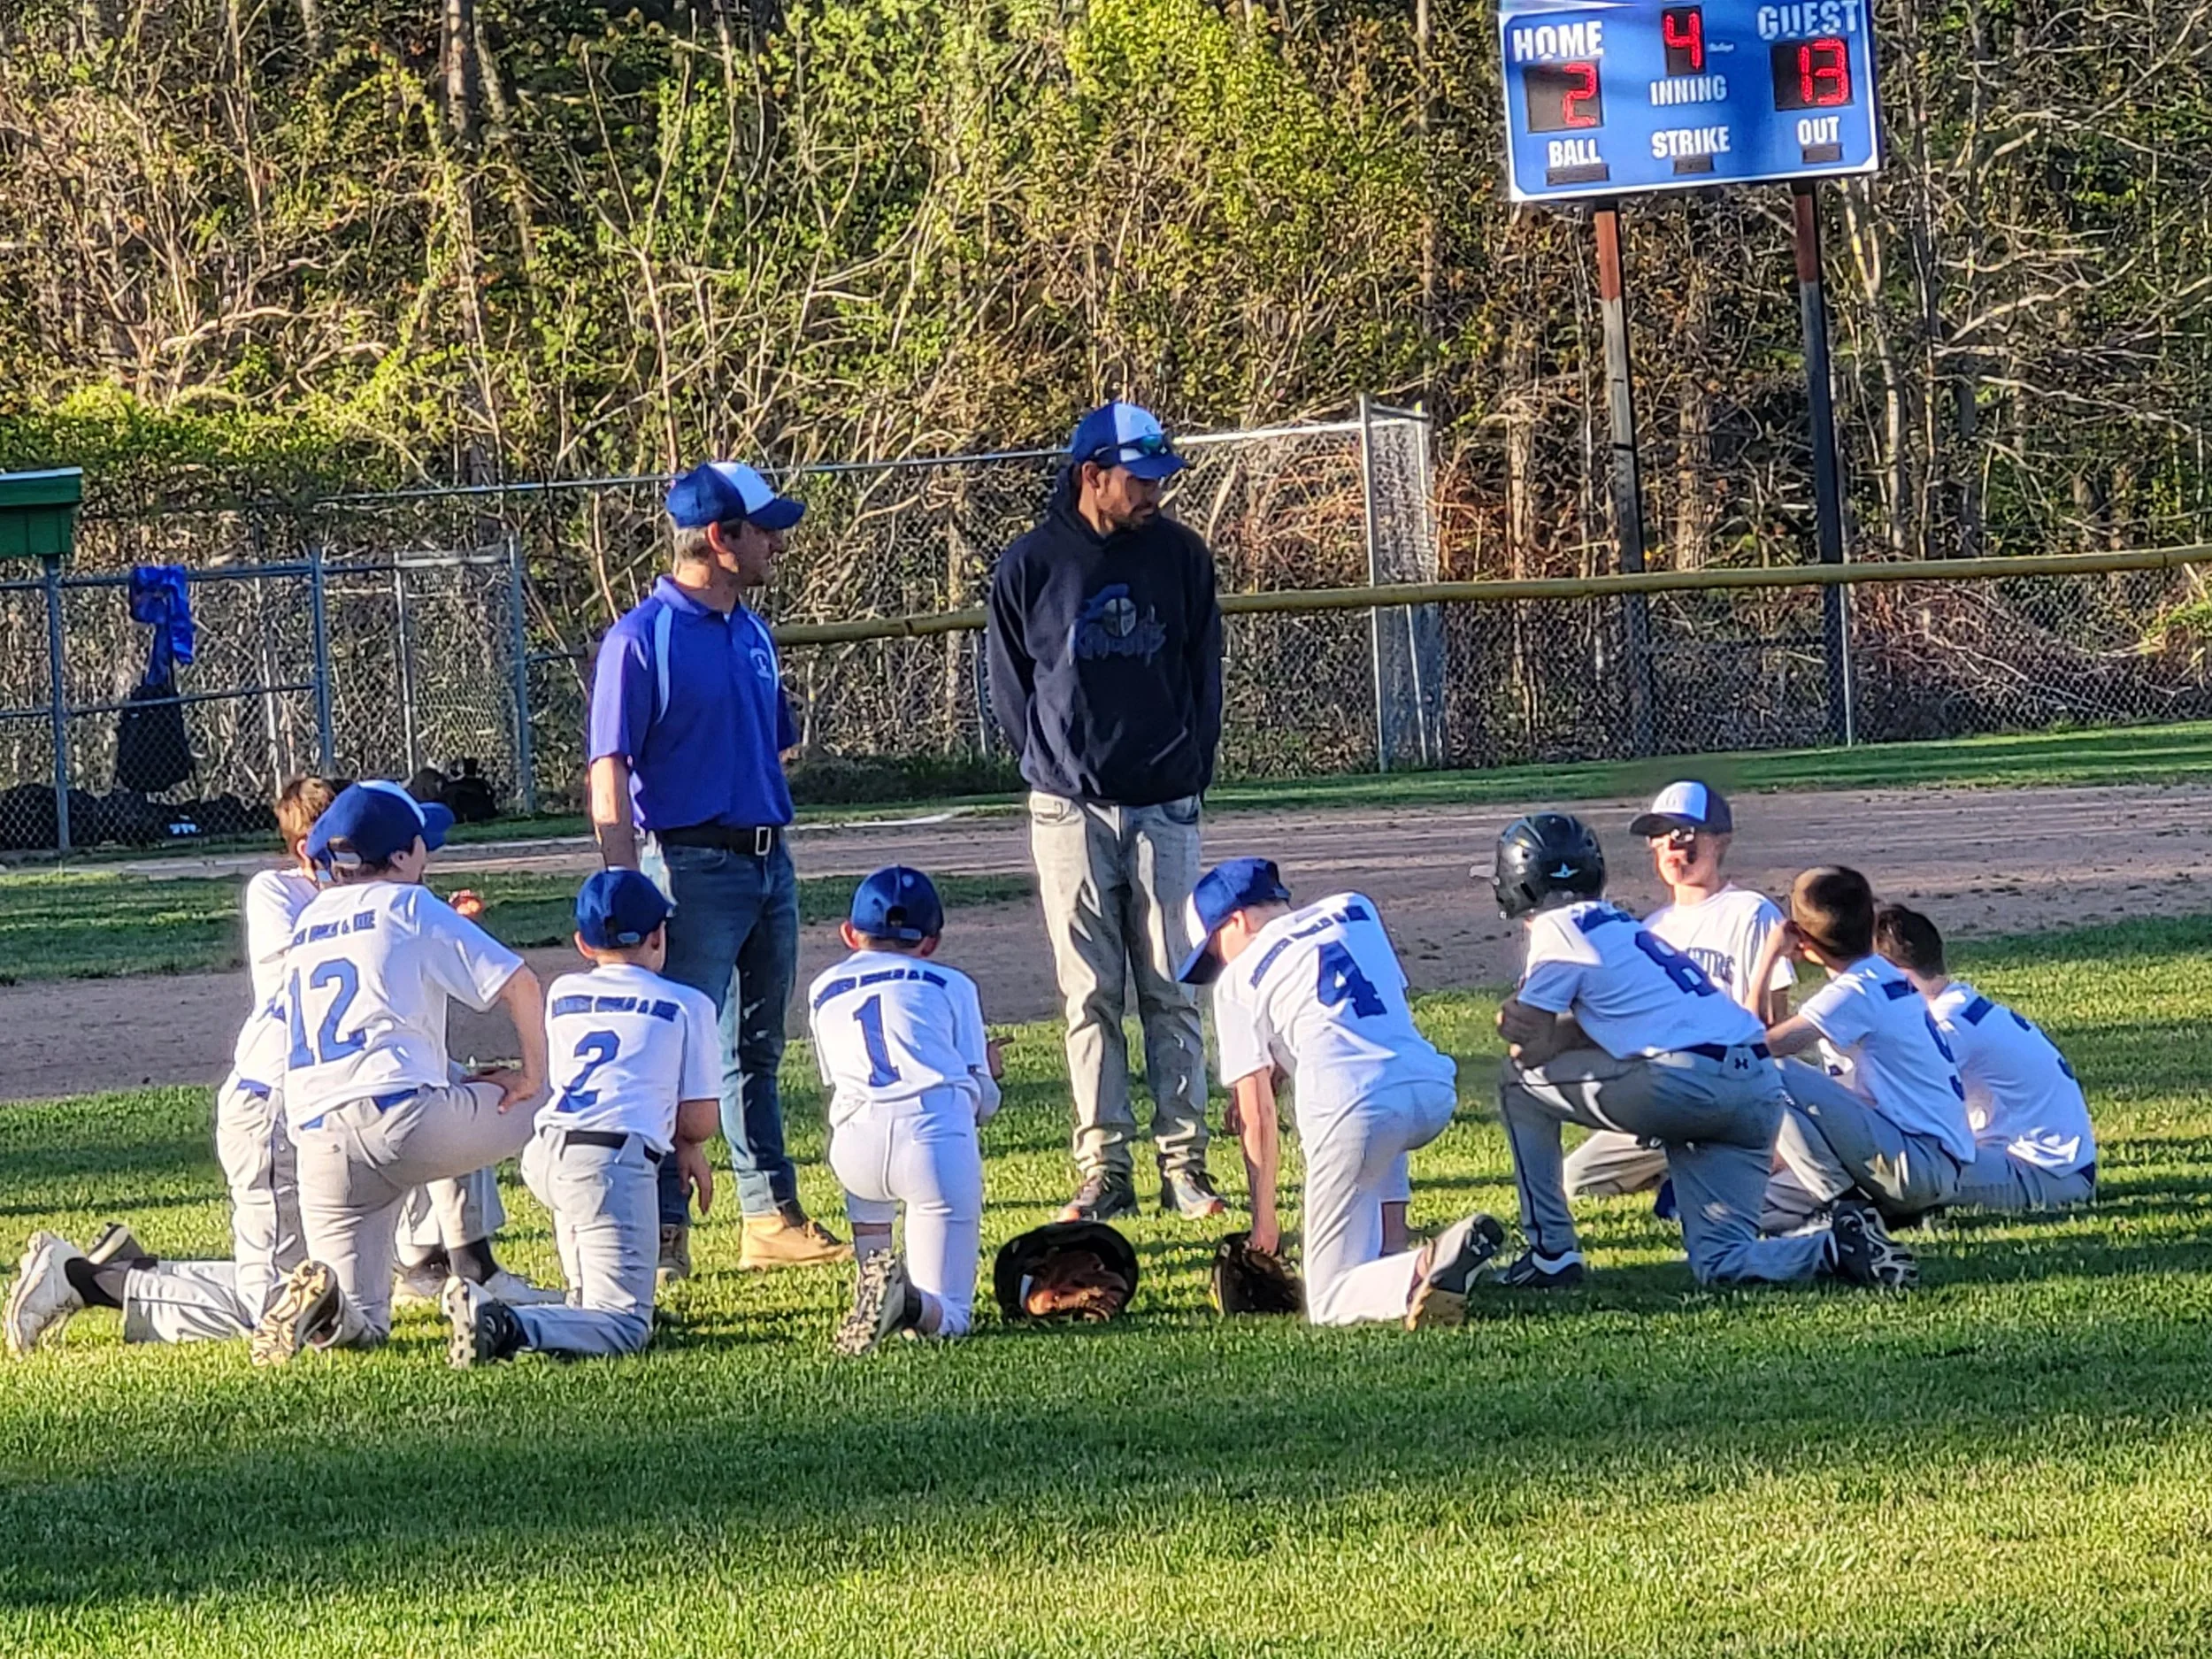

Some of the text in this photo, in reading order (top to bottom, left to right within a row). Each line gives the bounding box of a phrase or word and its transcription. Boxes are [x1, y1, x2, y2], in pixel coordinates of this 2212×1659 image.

[1513, 21, 1604, 62] HOME
[1663, 12, 1701, 70] 4
[1757, 0, 1858, 40] GUEST
[1562, 62, 1598, 127] 2
[1650, 75, 1727, 106] INNING
[1798, 38, 1847, 106] 13
[1548, 139, 1602, 167] BALL
[1652, 127, 1731, 158] STRIKE
[1797, 117, 1839, 145] OUT
[1317, 940, 1387, 1018] 4
[1635, 931, 1718, 997] 8
[288, 957, 367, 1071] 12
[852, 993, 902, 1087] 1
[554, 1030, 620, 1113] 2
